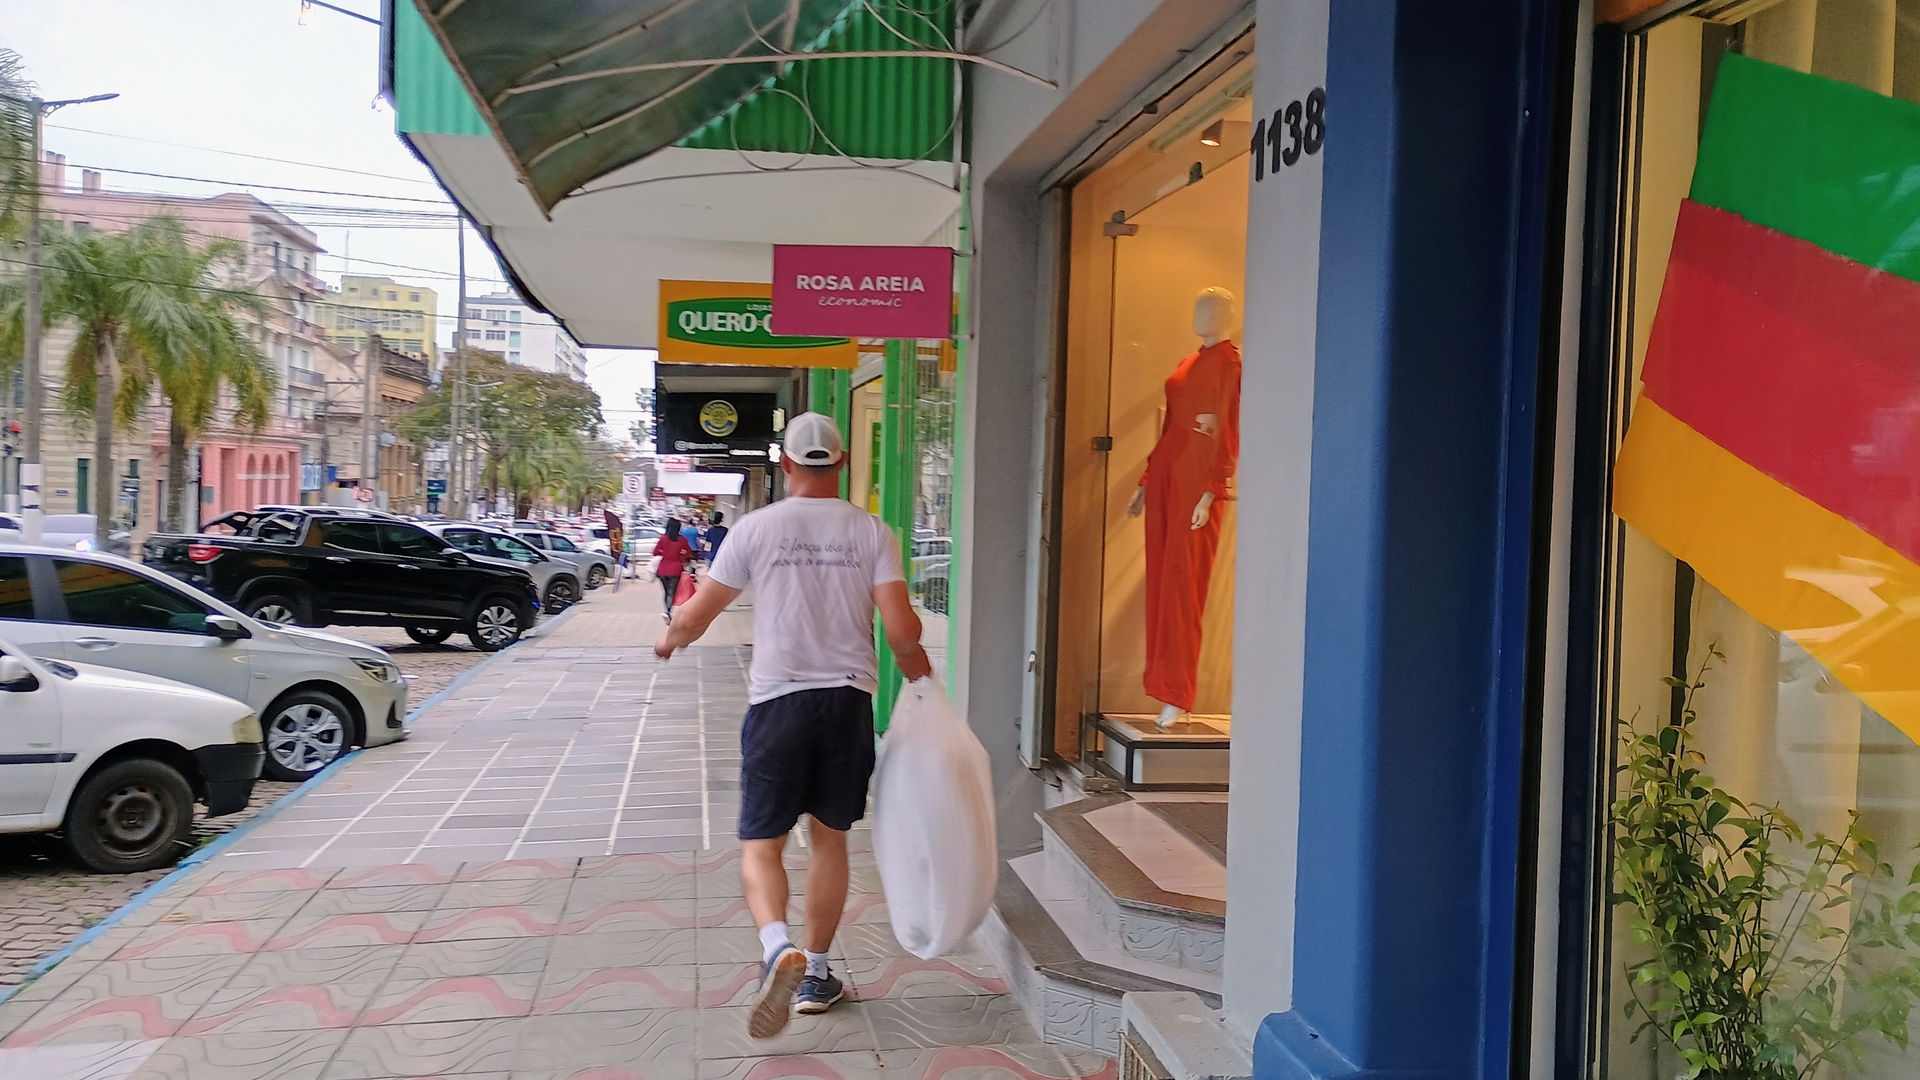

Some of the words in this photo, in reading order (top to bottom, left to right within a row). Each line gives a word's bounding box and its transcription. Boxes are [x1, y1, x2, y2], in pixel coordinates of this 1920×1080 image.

[1250, 87, 1326, 182] 1138
[796, 274, 855, 290] ROSA
[859, 275, 925, 292] AREIA
[818, 293, 902, 307] economic
